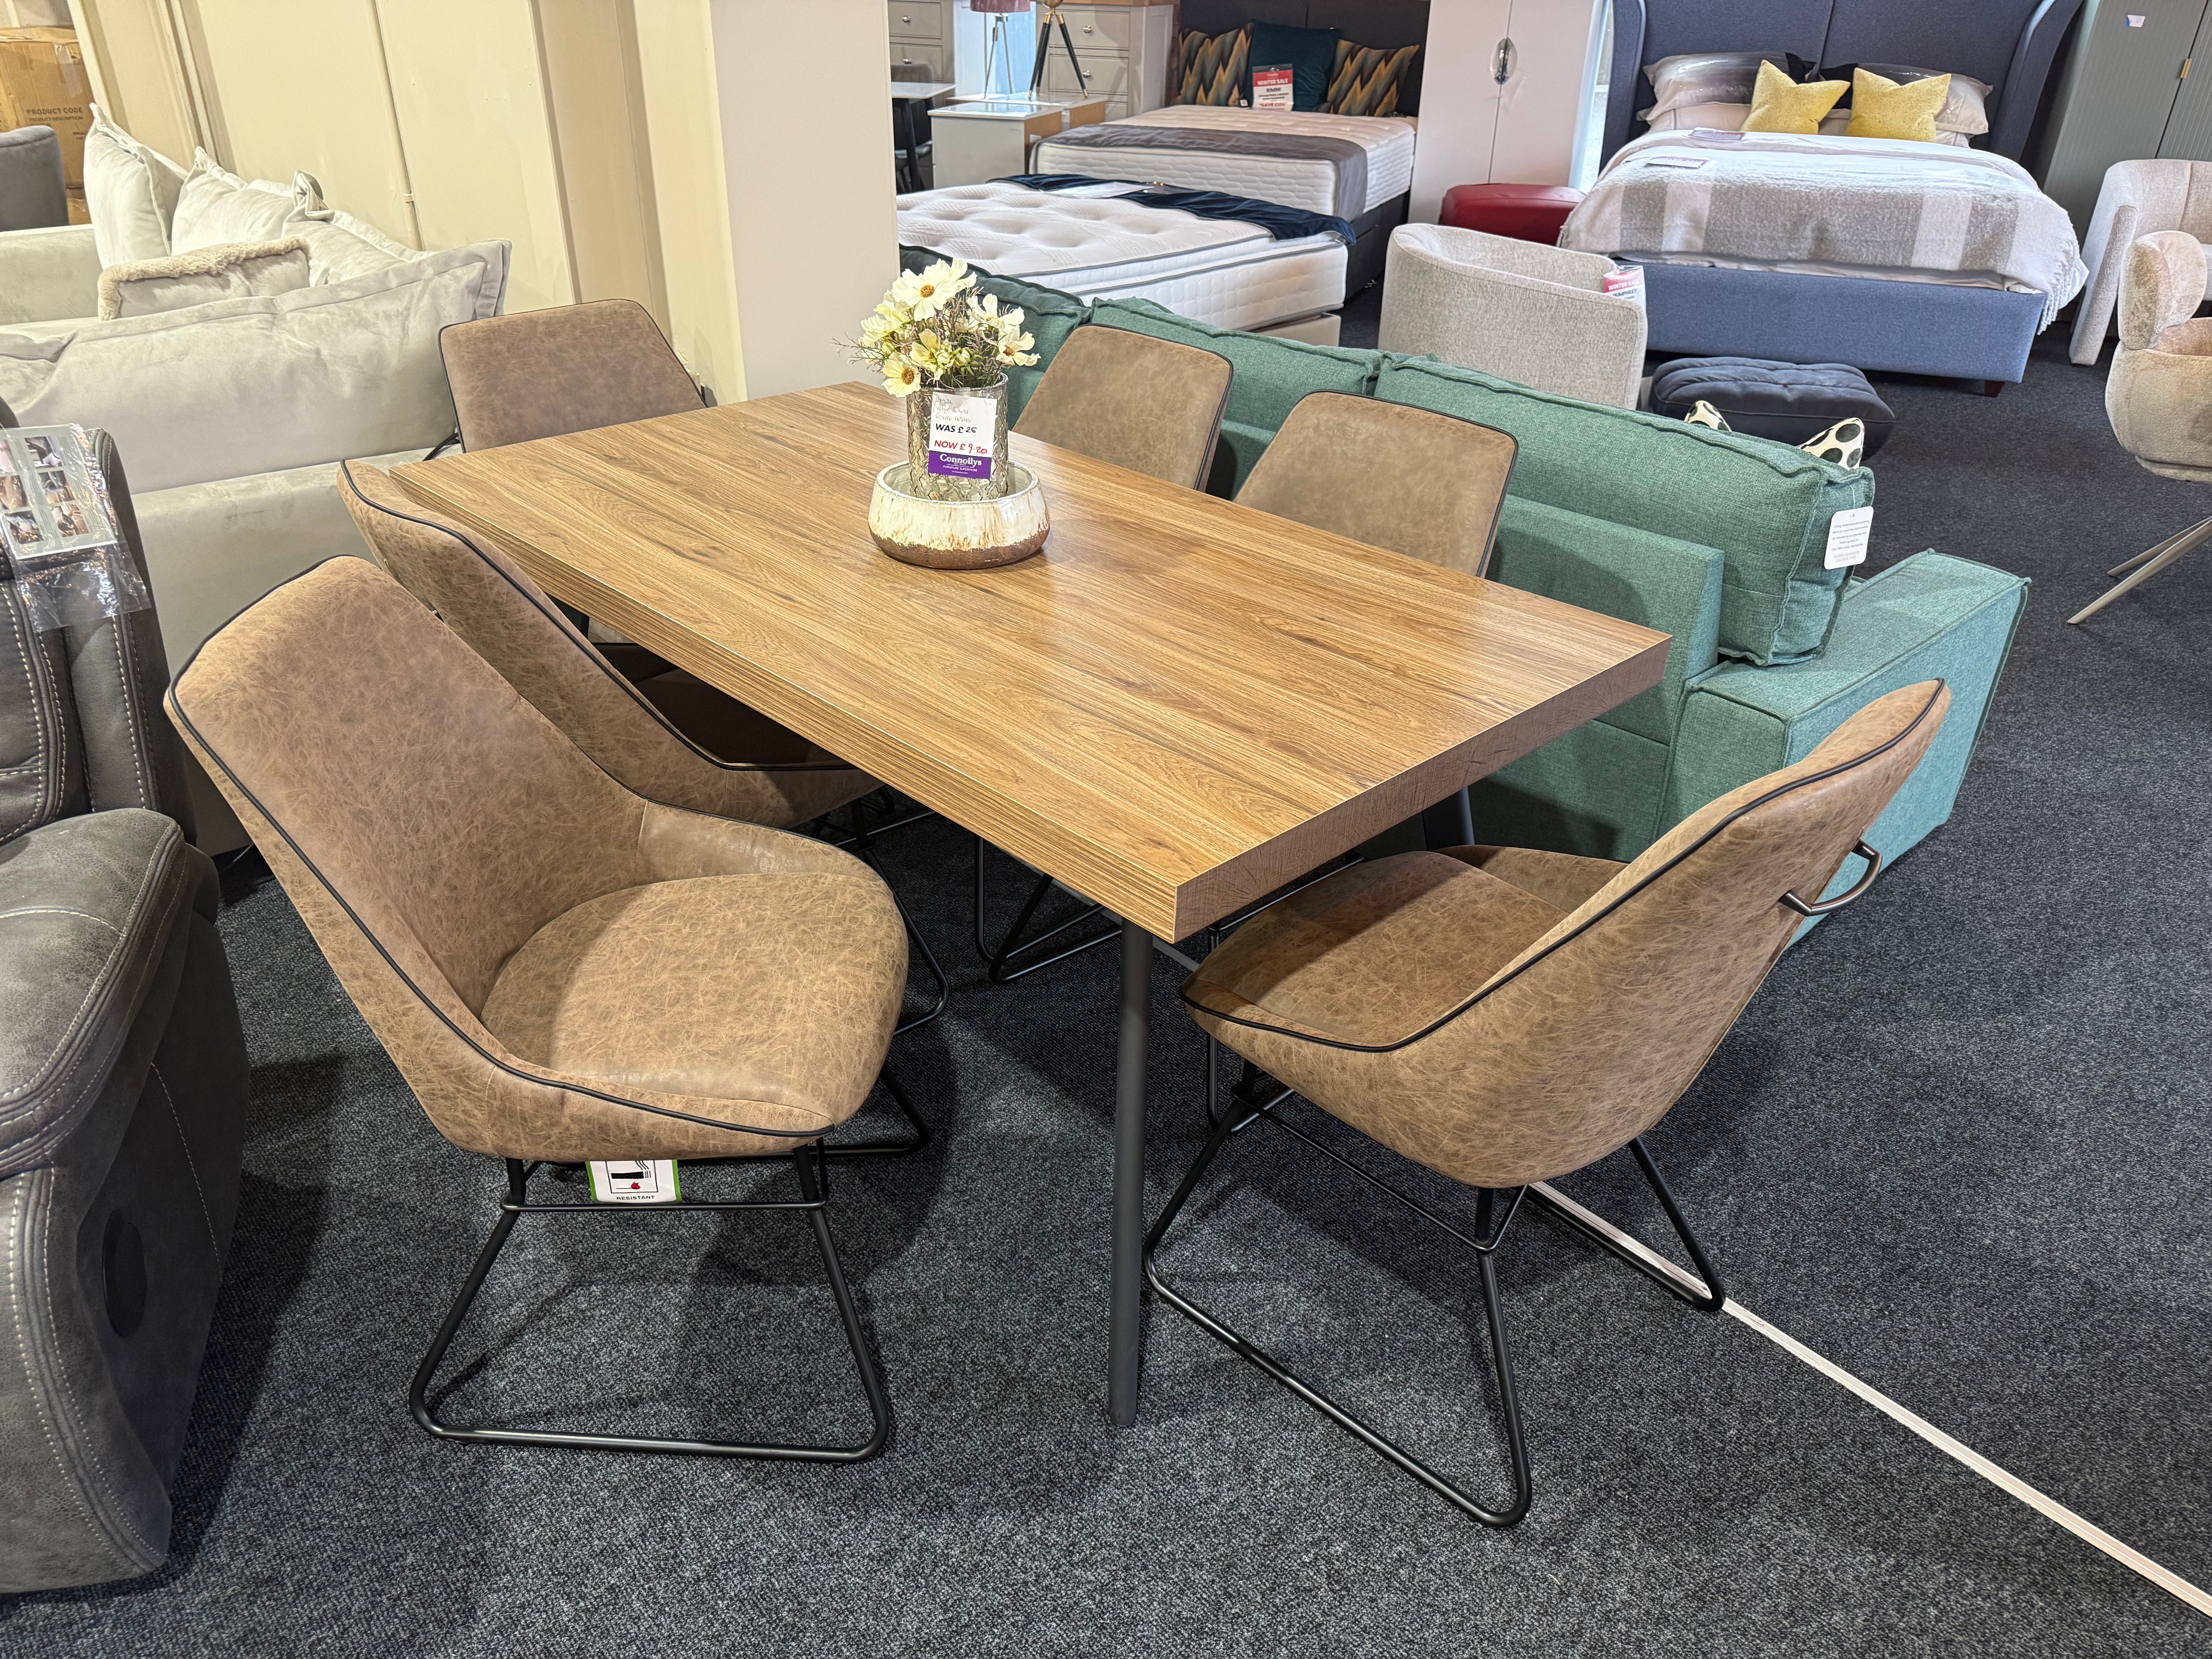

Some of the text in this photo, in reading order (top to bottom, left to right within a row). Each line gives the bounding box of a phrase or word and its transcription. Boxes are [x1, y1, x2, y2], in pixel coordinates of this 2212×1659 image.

[1608, 282, 1627, 290] WINTER
[936, 423, 955, 432] WAS
[934, 440, 958, 449] NOW
[939, 454, 982, 467] Connollys
